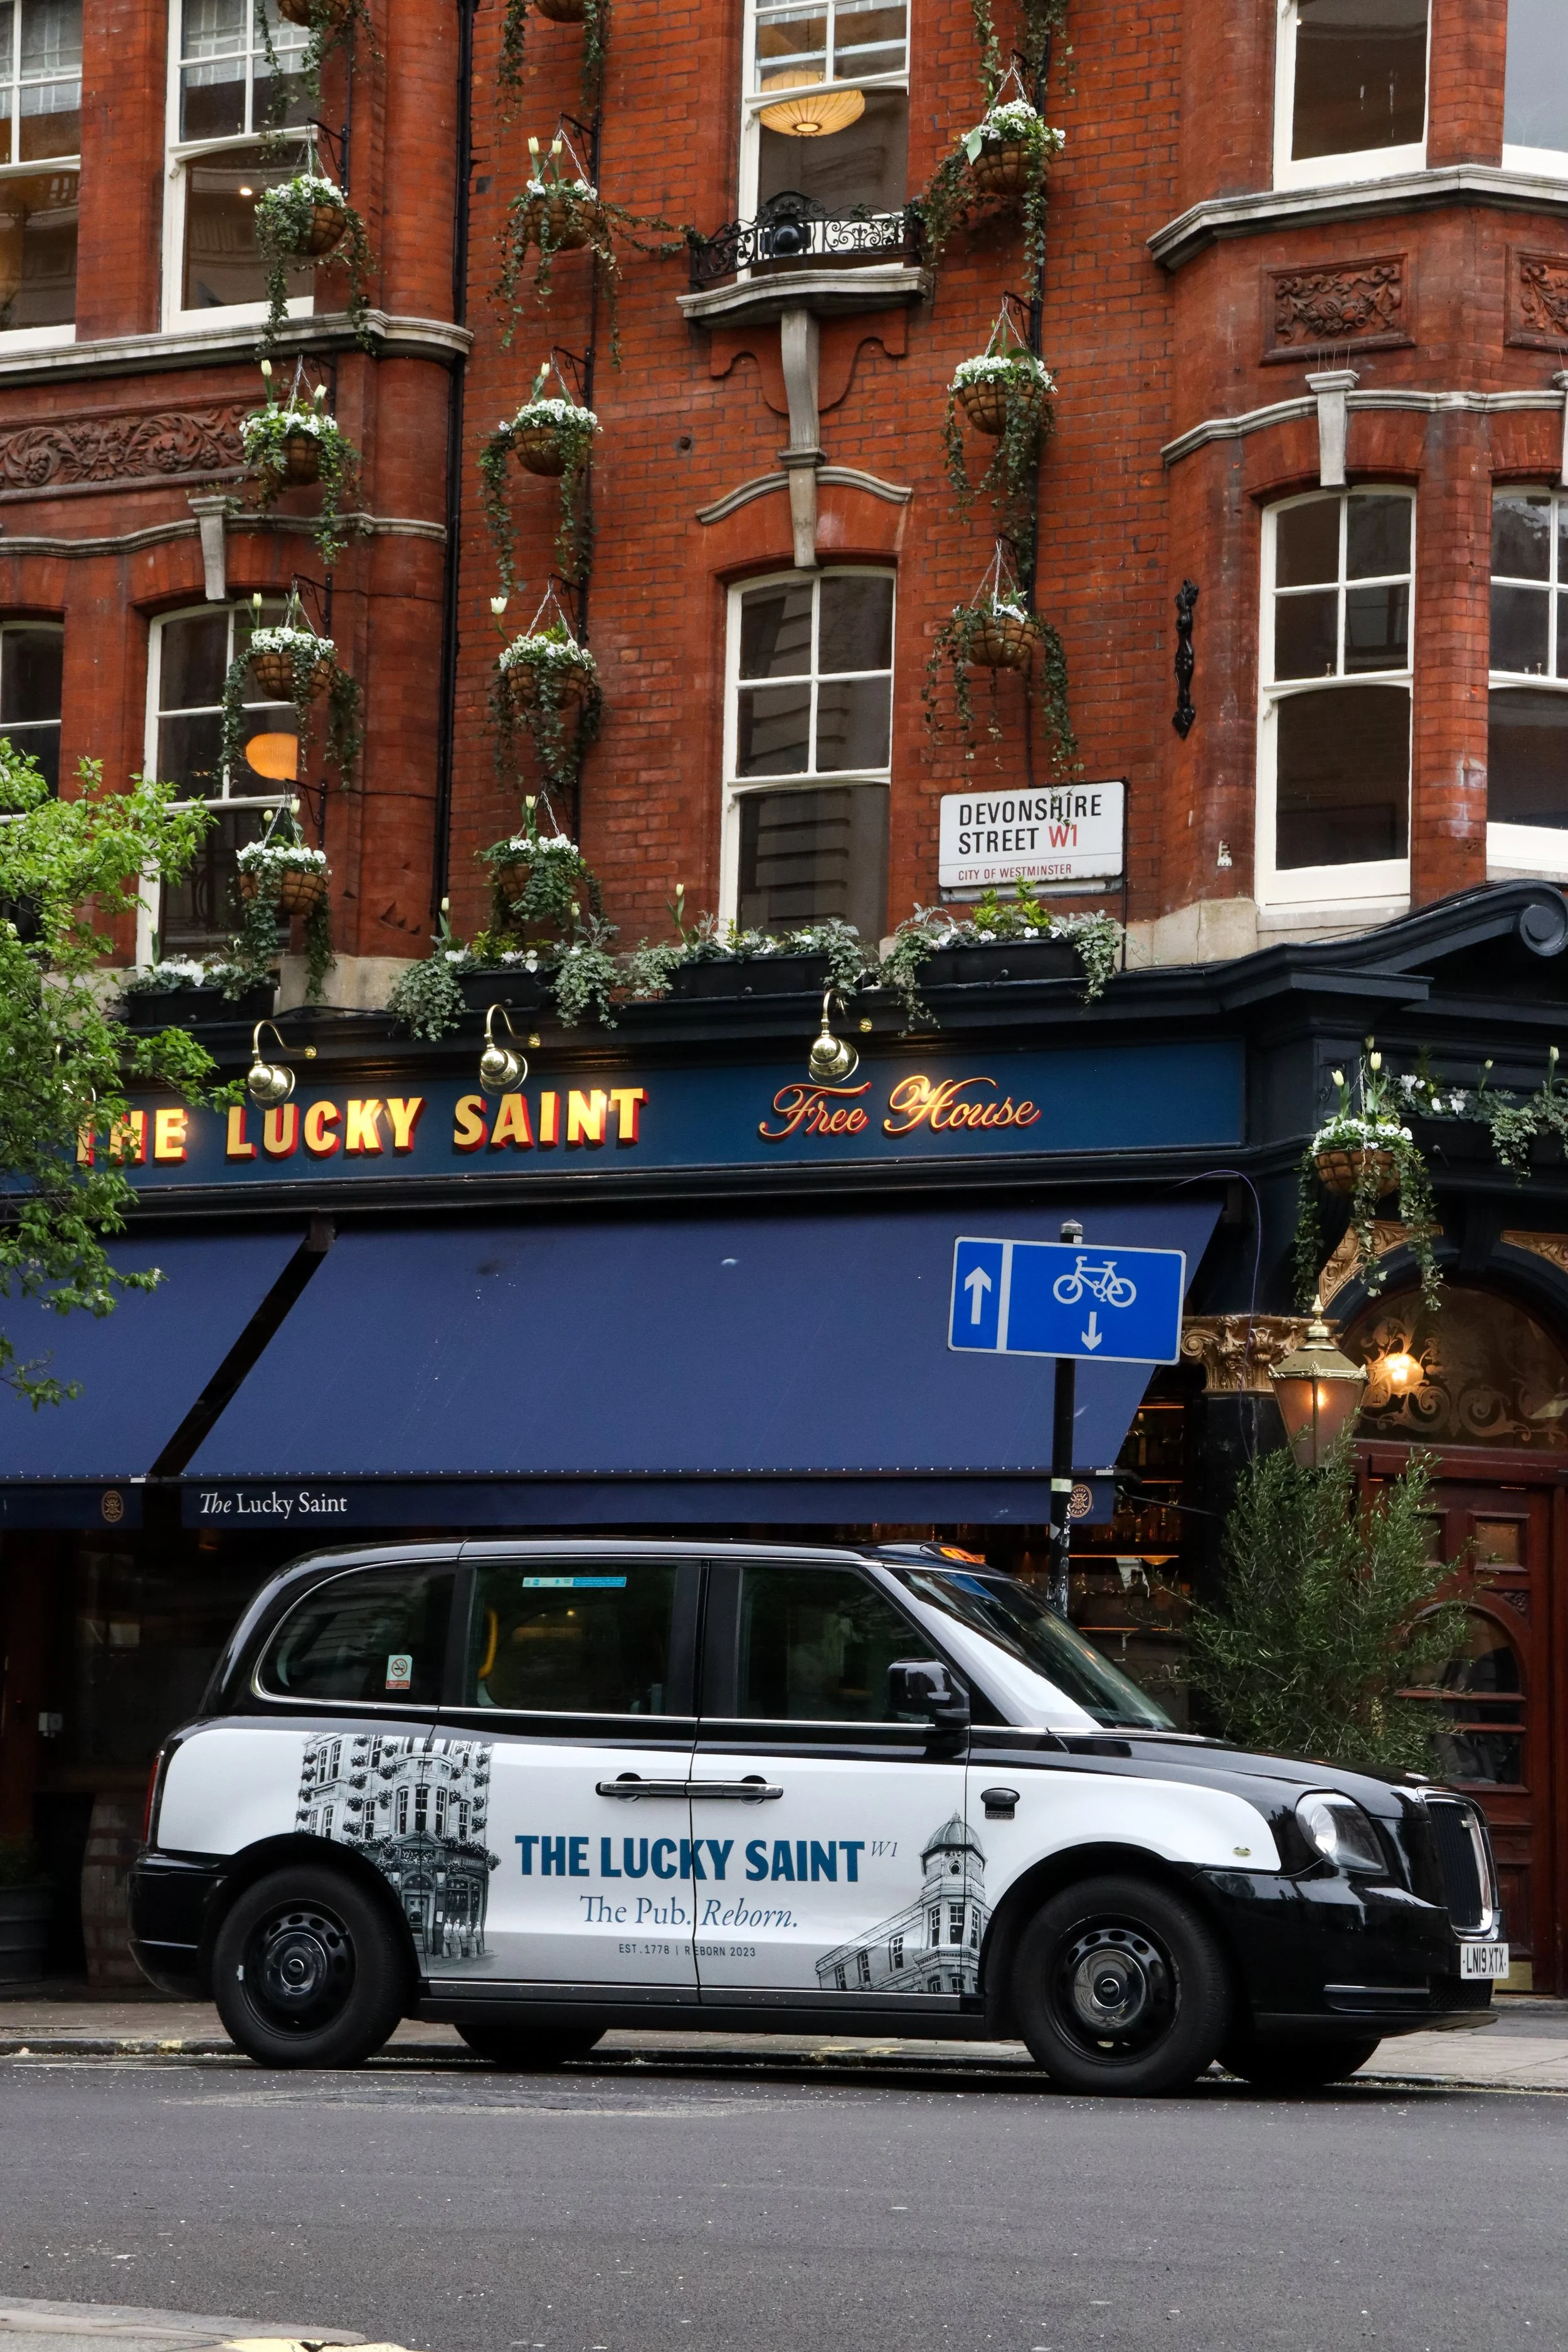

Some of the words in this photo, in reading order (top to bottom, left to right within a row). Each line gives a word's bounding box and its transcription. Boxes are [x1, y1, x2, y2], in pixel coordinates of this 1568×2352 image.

[959, 794, 1103, 826] DEVONSHIRE
[958, 827, 1039, 855] STREET
[1048, 824, 1078, 848] W1
[958, 869, 980, 881] CITY
[983, 868, 996, 879] OF
[999, 864, 1072, 878] WESTMINSTER
[759, 1081, 872, 1140] Free
[883, 1074, 1042, 1133] House
[226, 1097, 427, 1159] LUCKY
[453, 1088, 649, 1152] SAINT
[200, 1492, 232, 1513] The
[236, 1491, 294, 1520] Lucky
[299, 1492, 347, 1513] Saint
[515, 1835, 590, 1877] THE
[600, 1836, 734, 1880] LUCKY
[745, 1840, 865, 1882] SAINT
[871, 1840, 898, 1858] W1
[580, 1895, 627, 1923] The
[634, 1896, 691, 1925] Pub.
[699, 1897, 798, 1927] Reborn.
[685, 1946, 726, 1956] REBORN
[730, 1947, 756, 1957] 2023
[1466, 1947, 1486, 1973] LN19
[1488, 1947, 1504, 1973] XTX
